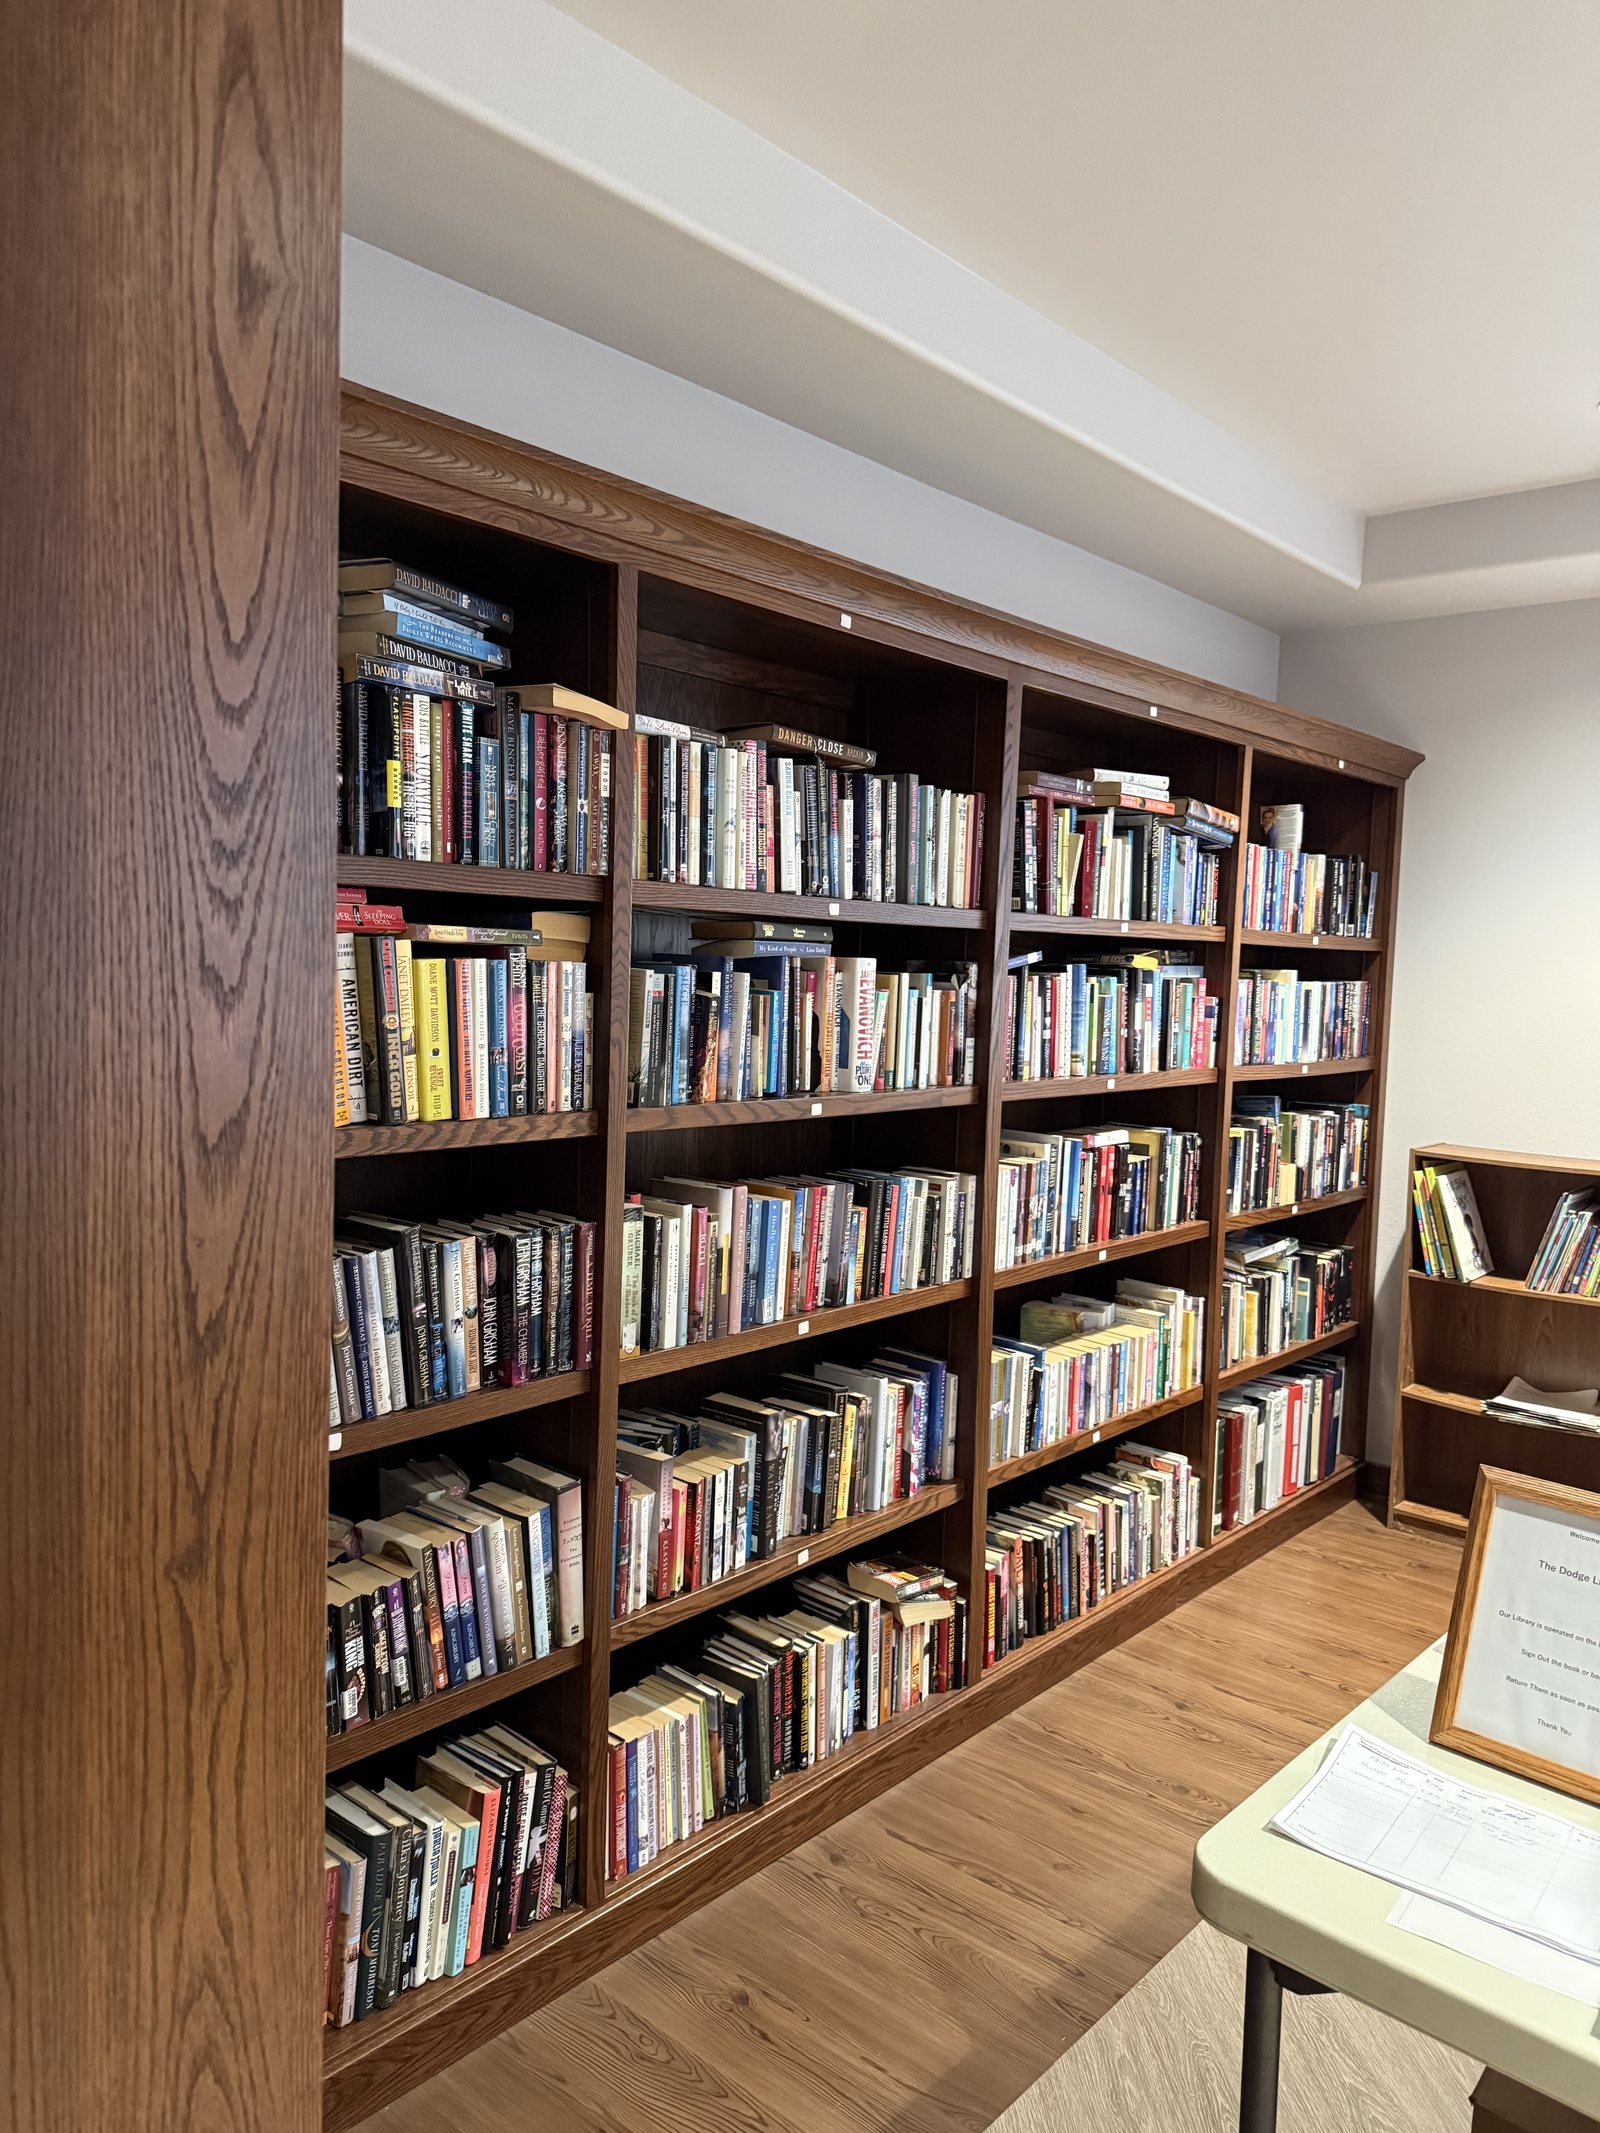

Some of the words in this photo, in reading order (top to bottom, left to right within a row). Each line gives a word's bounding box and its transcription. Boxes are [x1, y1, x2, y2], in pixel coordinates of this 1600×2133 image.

[396, 568, 420, 588] DAVID
[422, 578, 458, 604] BALDACCI
[390, 640, 416, 662] DAVID
[417, 650, 456, 675] BALDACCI
[373, 664, 400, 680] DAVID
[402, 671, 443, 690] BALDACCI
[454, 680, 477, 691] LAST
[457, 686, 478, 699] MILE
[402, 701, 413, 729] LINDA
[462, 708, 472, 734] WHITE
[462, 737, 472, 764] SHARK
[778, 728, 812, 748] DANGER
[817, 738, 844, 756] CLOSE
[404, 781, 414, 798] THE
[785, 762, 793, 789] SANDRA
[404, 802, 414, 817] BIG
[404, 821, 415, 837] DIG
[758, 828, 766, 855] smash
[758, 857, 766, 870] cut
[398, 955, 409, 986] JANET
[429, 963, 437, 984] DIANE
[400, 989, 411, 1024] DAILEY
[430, 986, 438, 1006] MOTT
[342, 979, 360, 1054] AMERICAN
[431, 1008, 439, 1042] DAVIDSON
[537, 1006, 545, 1019] THE
[857, 979, 874, 1060] EVANOVICH
[387, 1034, 399, 1070] INCA
[573, 1039, 583, 1056] JUDE
[349, 1057, 363, 1087] DIRT
[405, 1061, 415, 1100] HONOR
[537, 1057, 545, 1092] DAUGHTER
[574, 1058, 583, 1099] DEVERAUX
[389, 1072, 401, 1107] GOLD
[516, 1238, 529, 1263] JOHN
[532, 1237, 542, 1259] JOHN
[517, 1264, 530, 1306] GRISHAM
[564, 1263, 572, 1295] FIRM
[431, 1291, 439, 1319] LAWYER
[483, 1297, 496, 1321] JOHN
[531, 1276, 542, 1316] GRISHAM
[518, 1310, 528, 1327] THE
[415, 1324, 427, 1348] JOHN
[484, 1323, 497, 1366] GRISHAM
[518, 1329, 527, 1367] CHAMBER
[342, 1345, 351, 1367] JOHN
[373, 1347, 381, 1366] John
[418, 1349, 429, 1388] GRISHAM
[345, 1369, 355, 1405] GRISHAM
[364, 1380, 372, 1412] GRISHAM
[375, 1368, 383, 1401] Grisham
[767, 1464, 775, 1501] WALLY
[765, 1506, 773, 1536] LAMB
[1570, 1531, 1600, 1544] Welcome
[424, 1549, 437, 1609] KINGSBURY
[1539, 1560, 1556, 1572] The
[1559, 1566, 1590, 1582] Dodge
[1499, 1610, 1511, 1618] Our
[1512, 1614, 1535, 1627] Library
[1544, 1625, 1574, 1638] operated
[1586, 1638, 1596, 1646] the
[345, 1640, 358, 1672] KING
[1521, 1648, 1536, 1658] Sign
[1537, 1654, 1550, 1663] Out
[1551, 1660, 1562, 1668] the
[1564, 1662, 1580, 1673] book
[1506, 1675, 1528, 1687] Return
[1530, 1683, 1548, 1695] Them
[1560, 1695, 1576, 1704] soon
[1537, 1718, 1557, 1730] Thank
[545, 1767, 555, 1790] Carol
[369, 1928, 380, 1954] TONI
[365, 1958, 378, 2010] MORRISON
